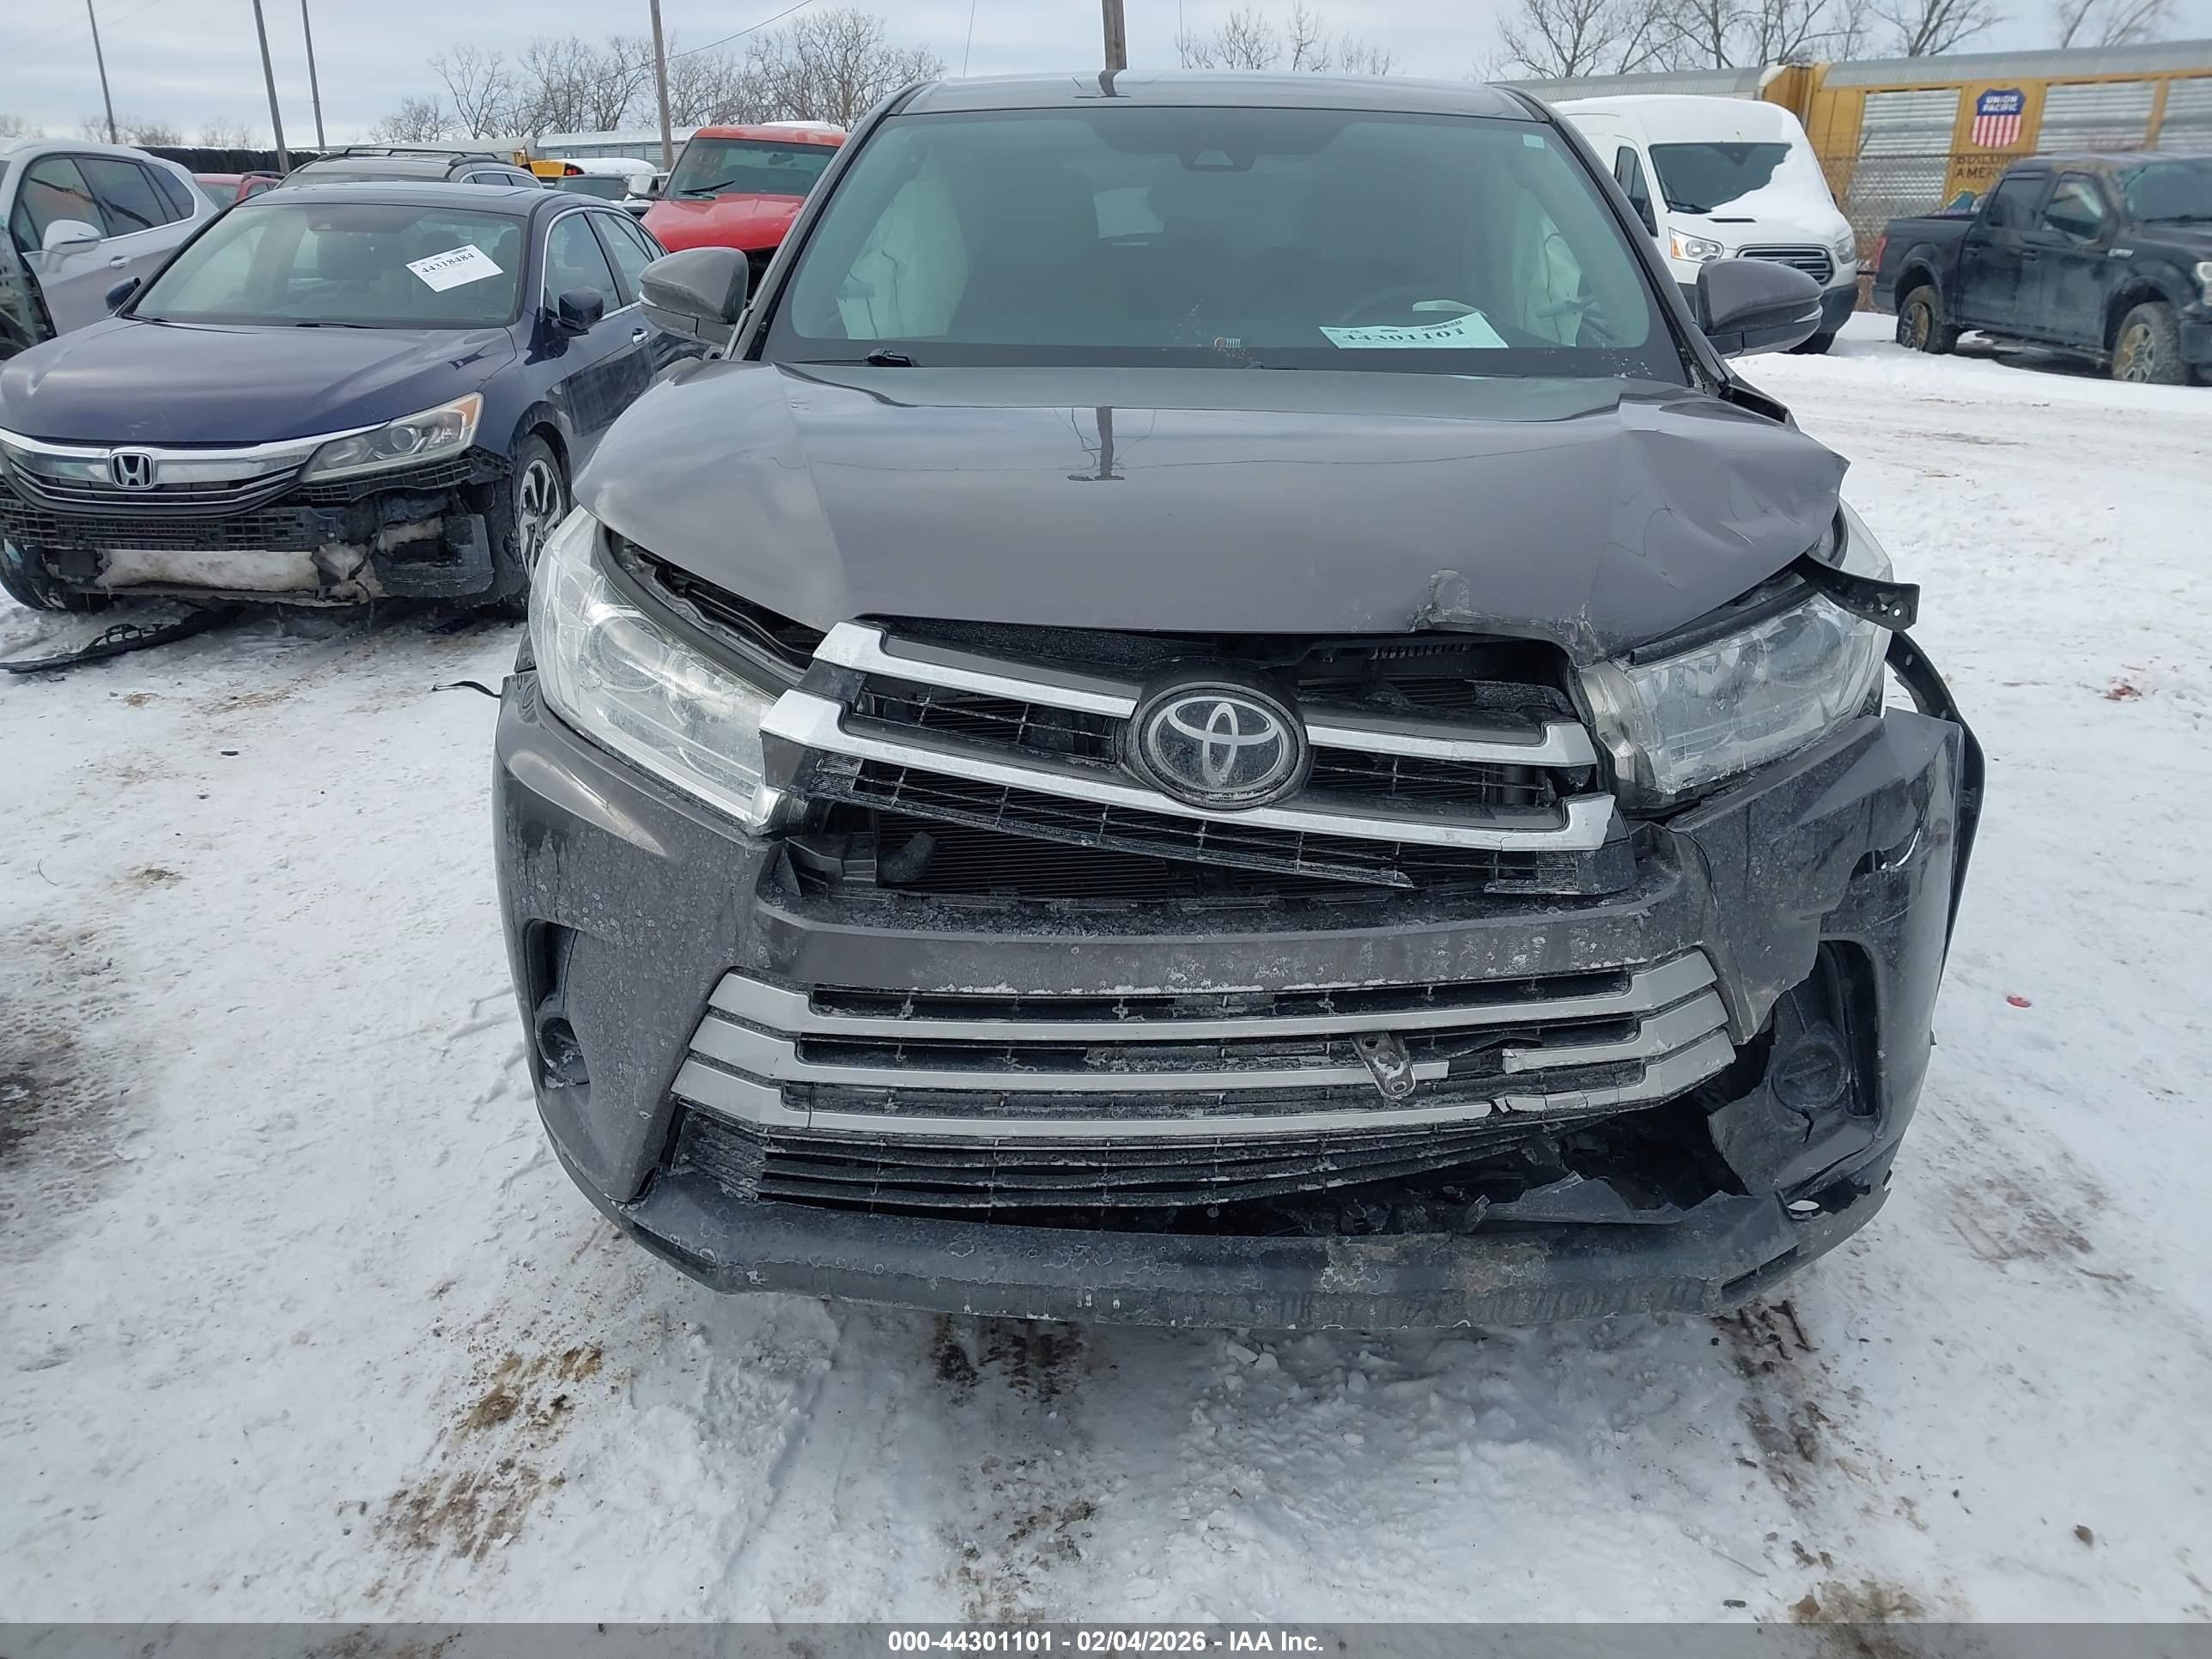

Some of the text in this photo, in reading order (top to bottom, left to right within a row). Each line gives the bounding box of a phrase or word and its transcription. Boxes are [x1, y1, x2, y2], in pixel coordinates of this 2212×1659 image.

[1984, 95, 2019, 104] UNION
[1982, 103, 2018, 112] PACIFIC
[1956, 167, 1996, 179] AMER
[422, 252, 475, 274] 44318484
